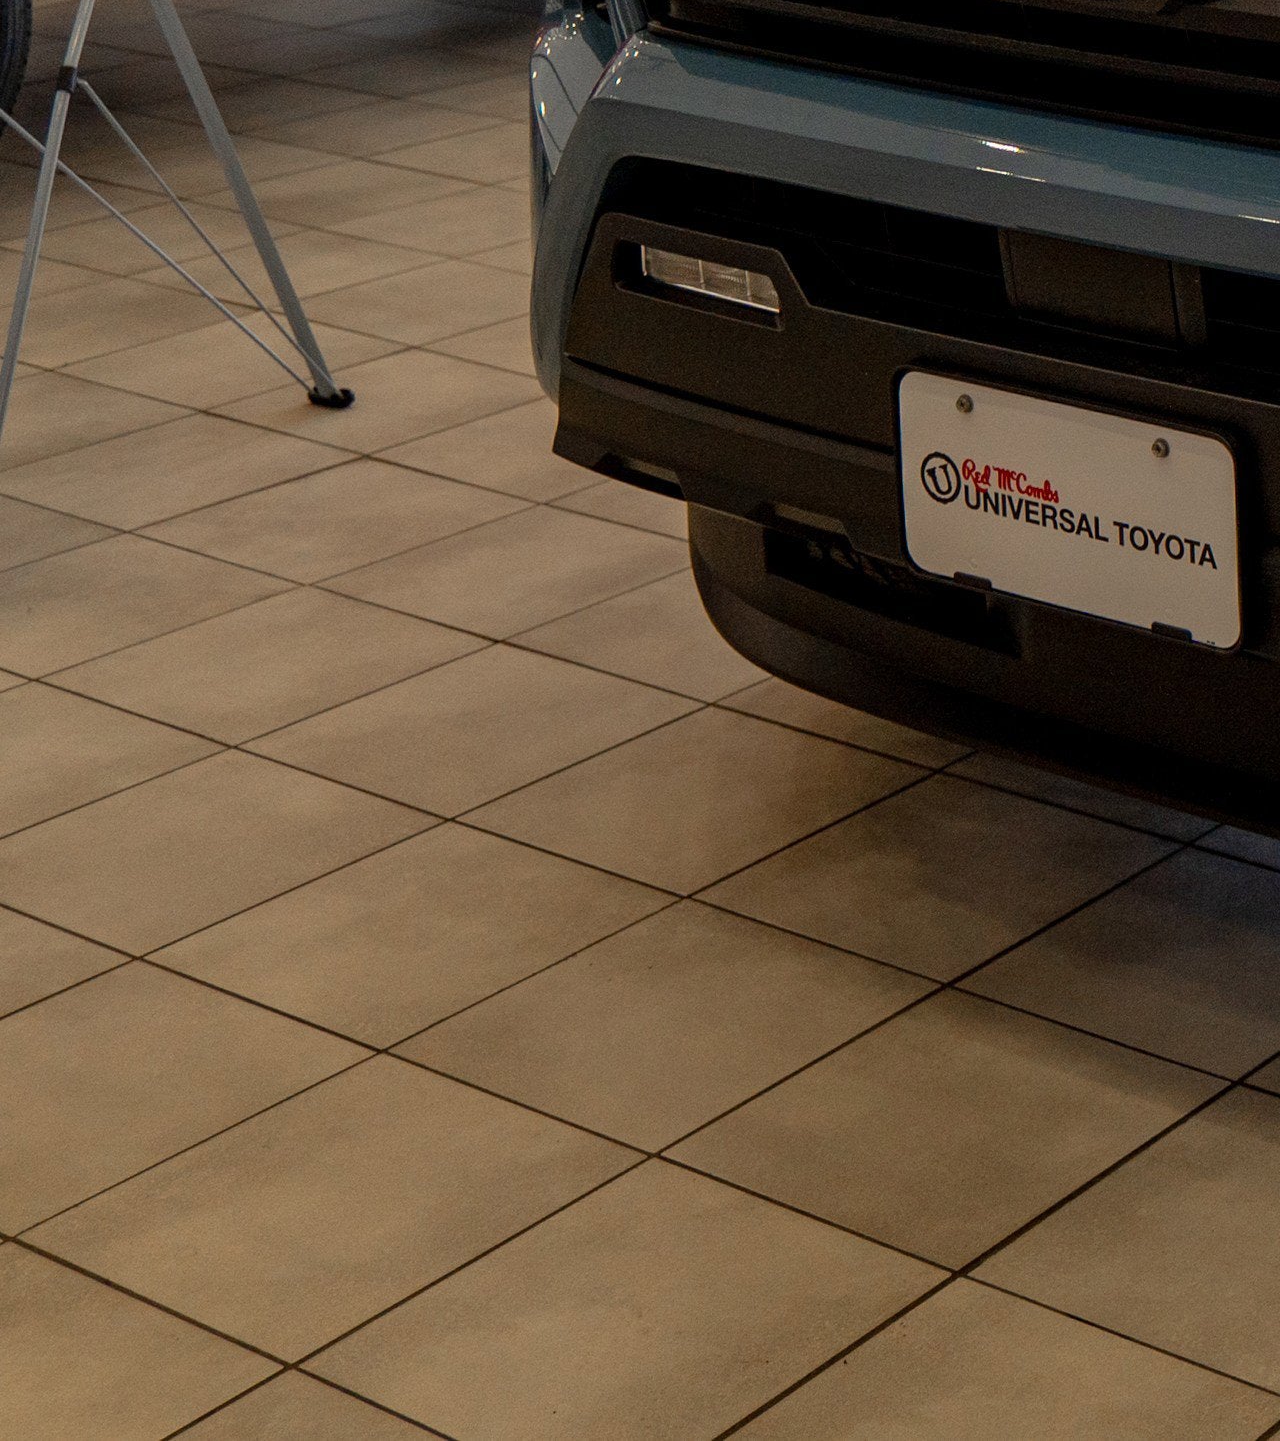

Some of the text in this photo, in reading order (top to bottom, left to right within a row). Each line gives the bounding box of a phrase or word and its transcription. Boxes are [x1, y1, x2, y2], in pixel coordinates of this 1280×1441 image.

[962, 458, 1060, 504] Red McCombs
[964, 484, 1218, 570] UNIVERSAL TOYOTA
